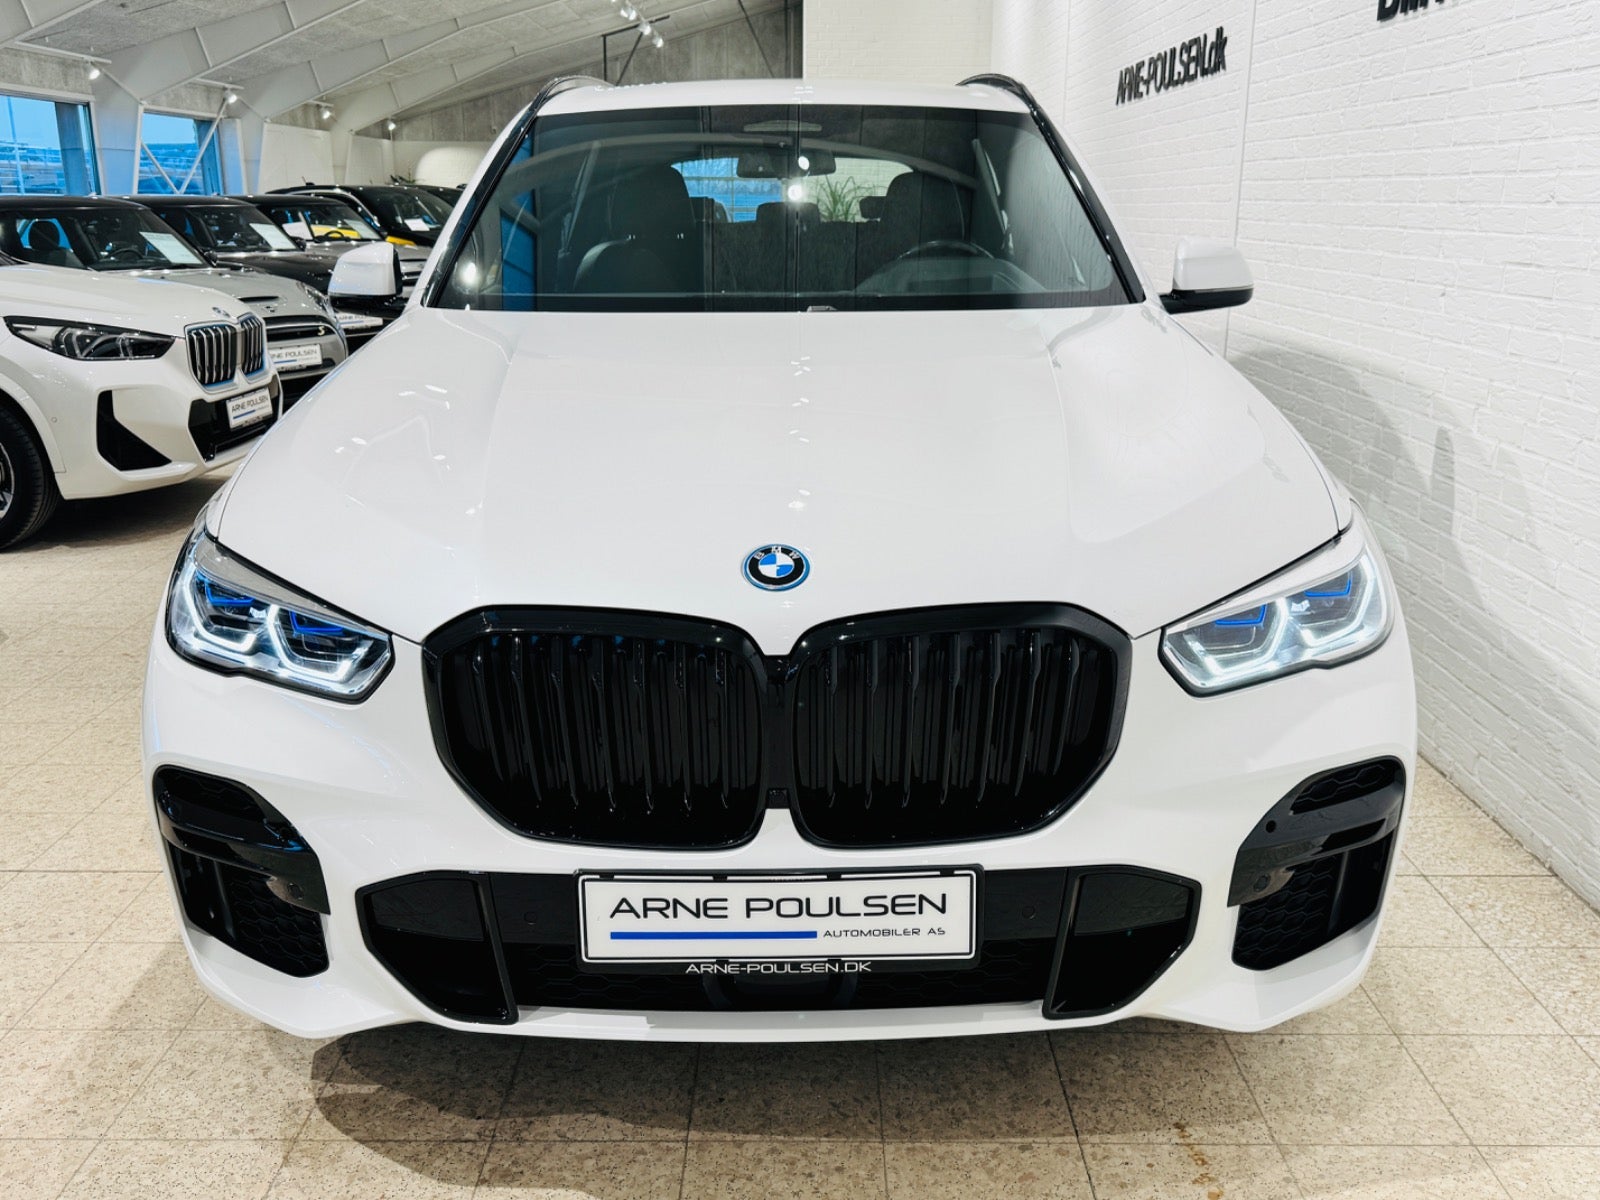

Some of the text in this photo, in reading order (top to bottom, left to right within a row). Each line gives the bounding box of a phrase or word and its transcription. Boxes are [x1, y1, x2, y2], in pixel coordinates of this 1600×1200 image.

[317, 326, 325, 336] S
[285, 350, 317, 358] POULSEN
[231, 402, 246, 413] ARNE
[610, 893, 947, 920] ARNE POULSEN
[823, 927, 946, 938] AUTOMOBILER AS
[685, 961, 872, 975] ARNE-POULSEN.DK
